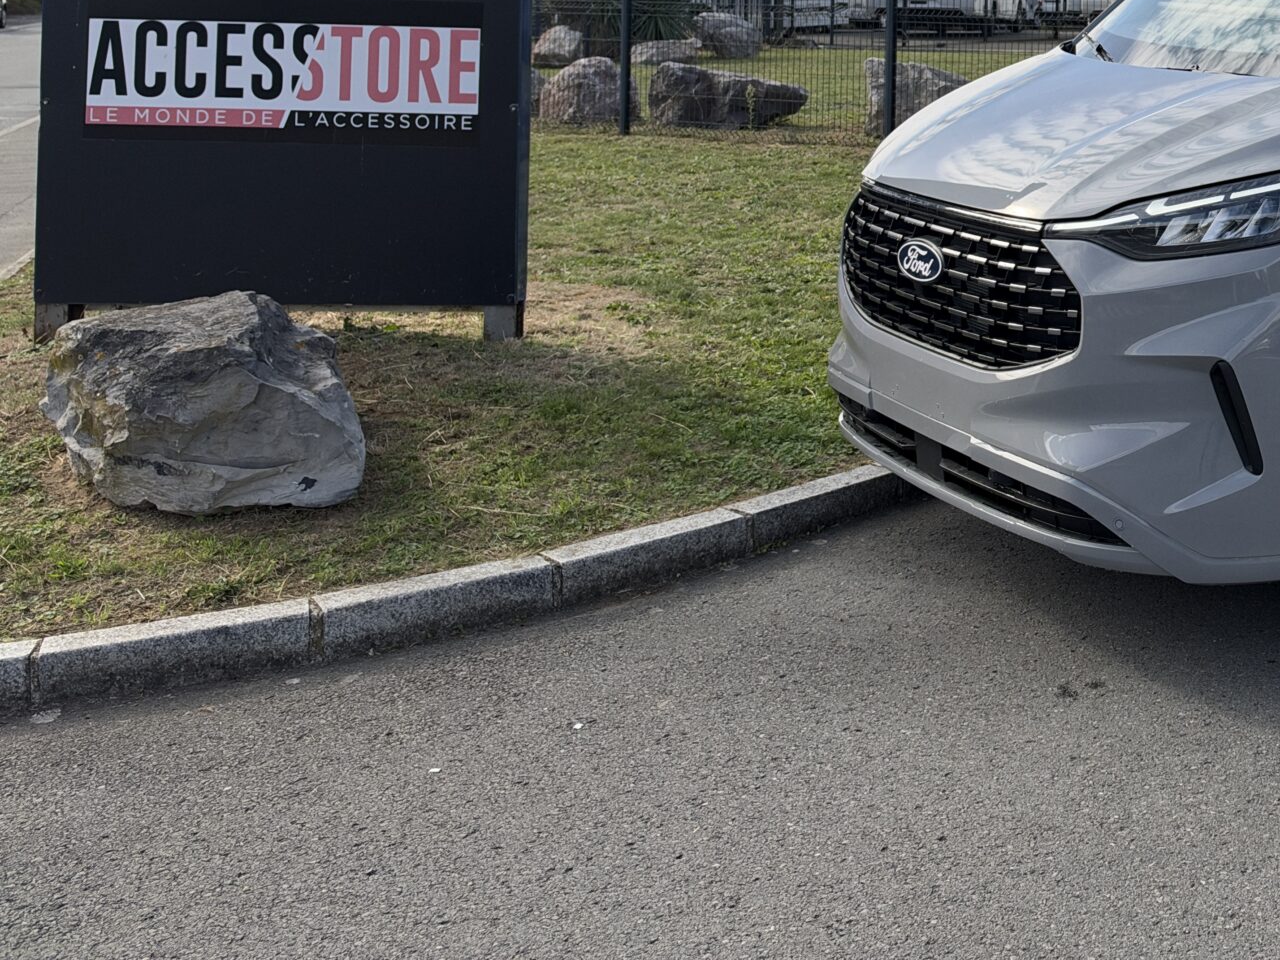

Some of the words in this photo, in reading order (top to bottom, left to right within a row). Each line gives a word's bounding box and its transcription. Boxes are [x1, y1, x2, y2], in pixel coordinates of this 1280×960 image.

[88, 20, 480, 105] ACCESSTORE
[89, 107, 119, 123] LE
[133, 108, 227, 125] MONDE
[242, 110, 273, 126] DE
[294, 112, 473, 131] L'ACCESSOIRE
[903, 245, 935, 277] Ford
